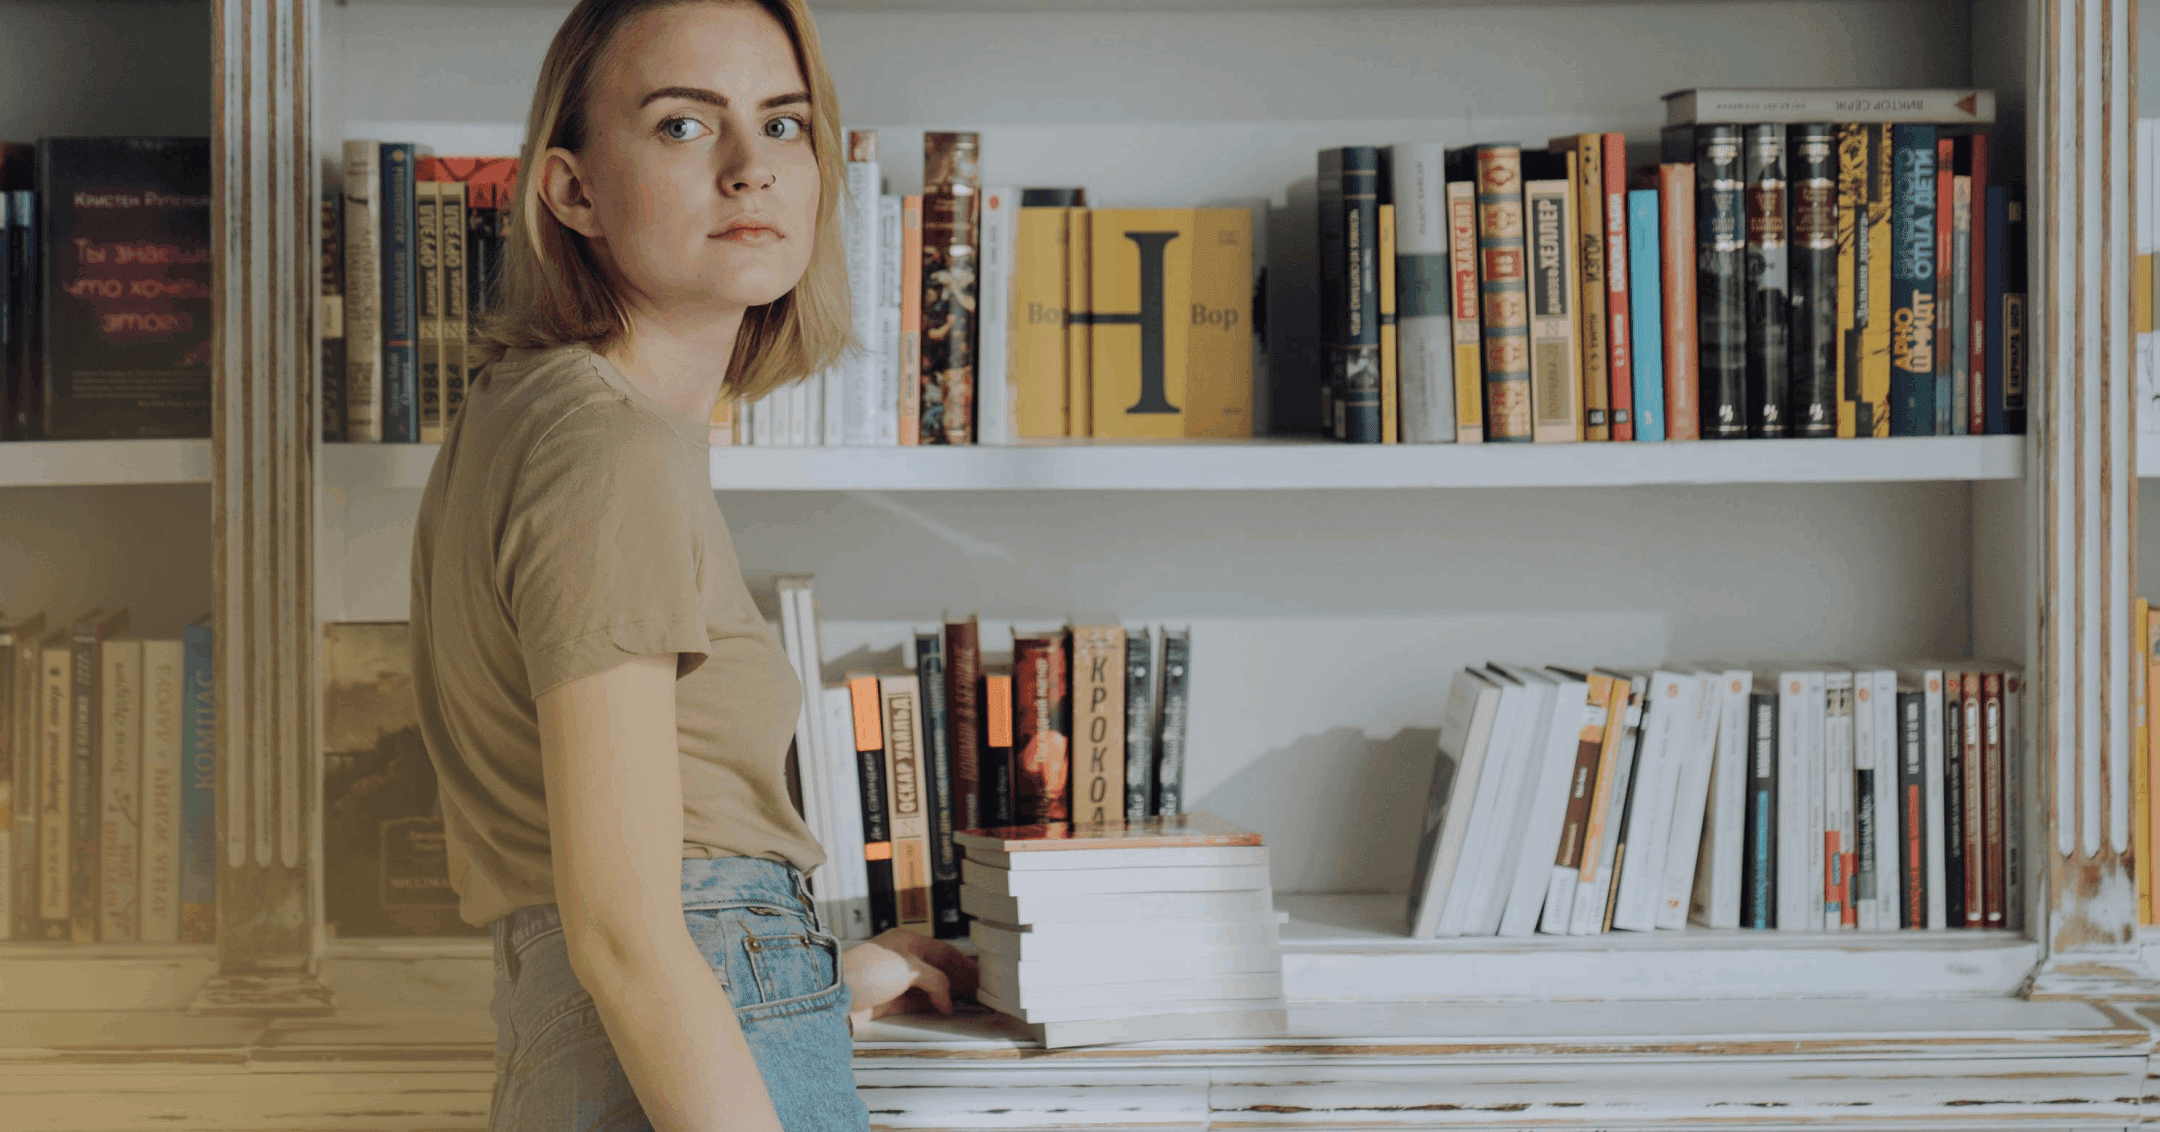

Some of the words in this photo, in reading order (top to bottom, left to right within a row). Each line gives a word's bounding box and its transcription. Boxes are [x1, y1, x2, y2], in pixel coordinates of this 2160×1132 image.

[1835, 98, 1871, 112] СЕРЖ
[1873, 98, 1924, 111] ВИКТОР
[1913, 148, 1936, 209] ДЕТИ
[418, 203, 437, 267] ОРУЭЛЛ
[444, 203, 461, 267] ОРУЭЛЛ
[1454, 202, 1474, 272] ХАКСЛИ
[1537, 198, 1560, 269] ХЕЛЛЕР
[1913, 213, 1933, 280] ОТЦА
[1191, 303, 1238, 331] Вор
[1461, 272, 1476, 318] ОЛДОС
[1894, 307, 1913, 371] АРНО
[1912, 288, 1934, 373] ШМИДТ
[421, 361, 439, 418] 1984
[447, 362, 464, 415] 1984
[154, 663, 172, 744] ЛАРОУЗ
[954, 645, 974, 706] БЕРЛИНЕ
[194, 669, 215, 790] КОМПАС
[891, 697, 912, 761] УАЙЛЬД
[958, 722, 978, 781] КОШМАР
[150, 767, 171, 843] ЭРДРИЧ
[898, 761, 916, 813] ОСКАР
[150, 852, 169, 920] ЛУИЗА
